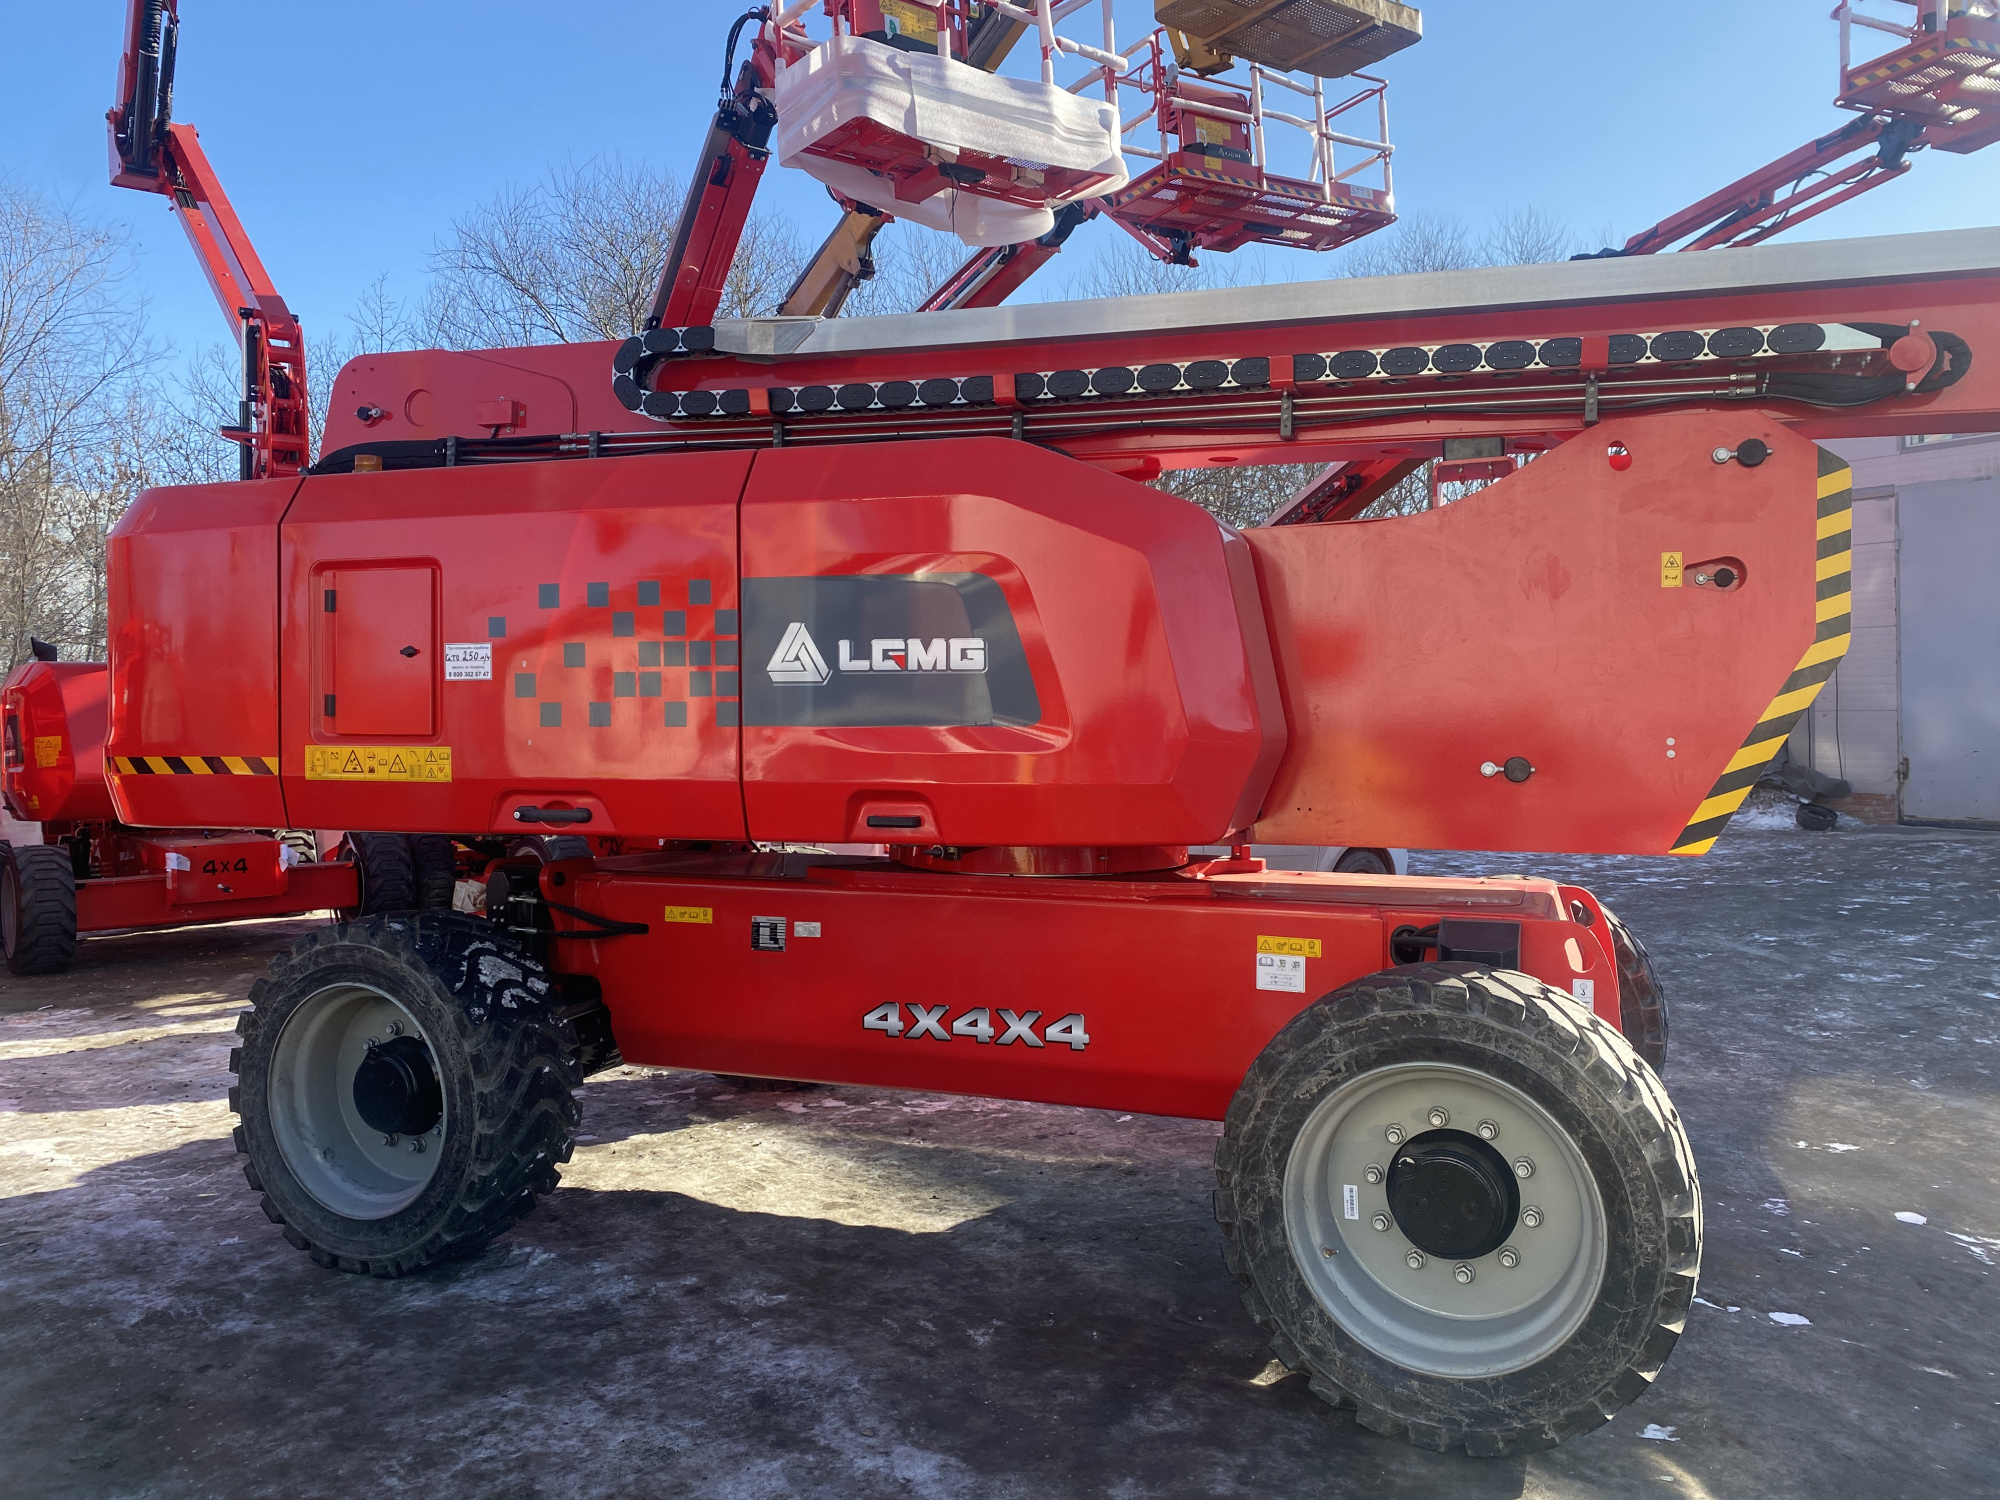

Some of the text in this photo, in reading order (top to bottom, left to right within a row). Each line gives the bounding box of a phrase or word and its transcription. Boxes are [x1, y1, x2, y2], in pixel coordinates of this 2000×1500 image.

[462, 650, 478, 662] 250
[838, 638, 988, 674] LGMG
[863, 1001, 1090, 1051] 4X4X4
